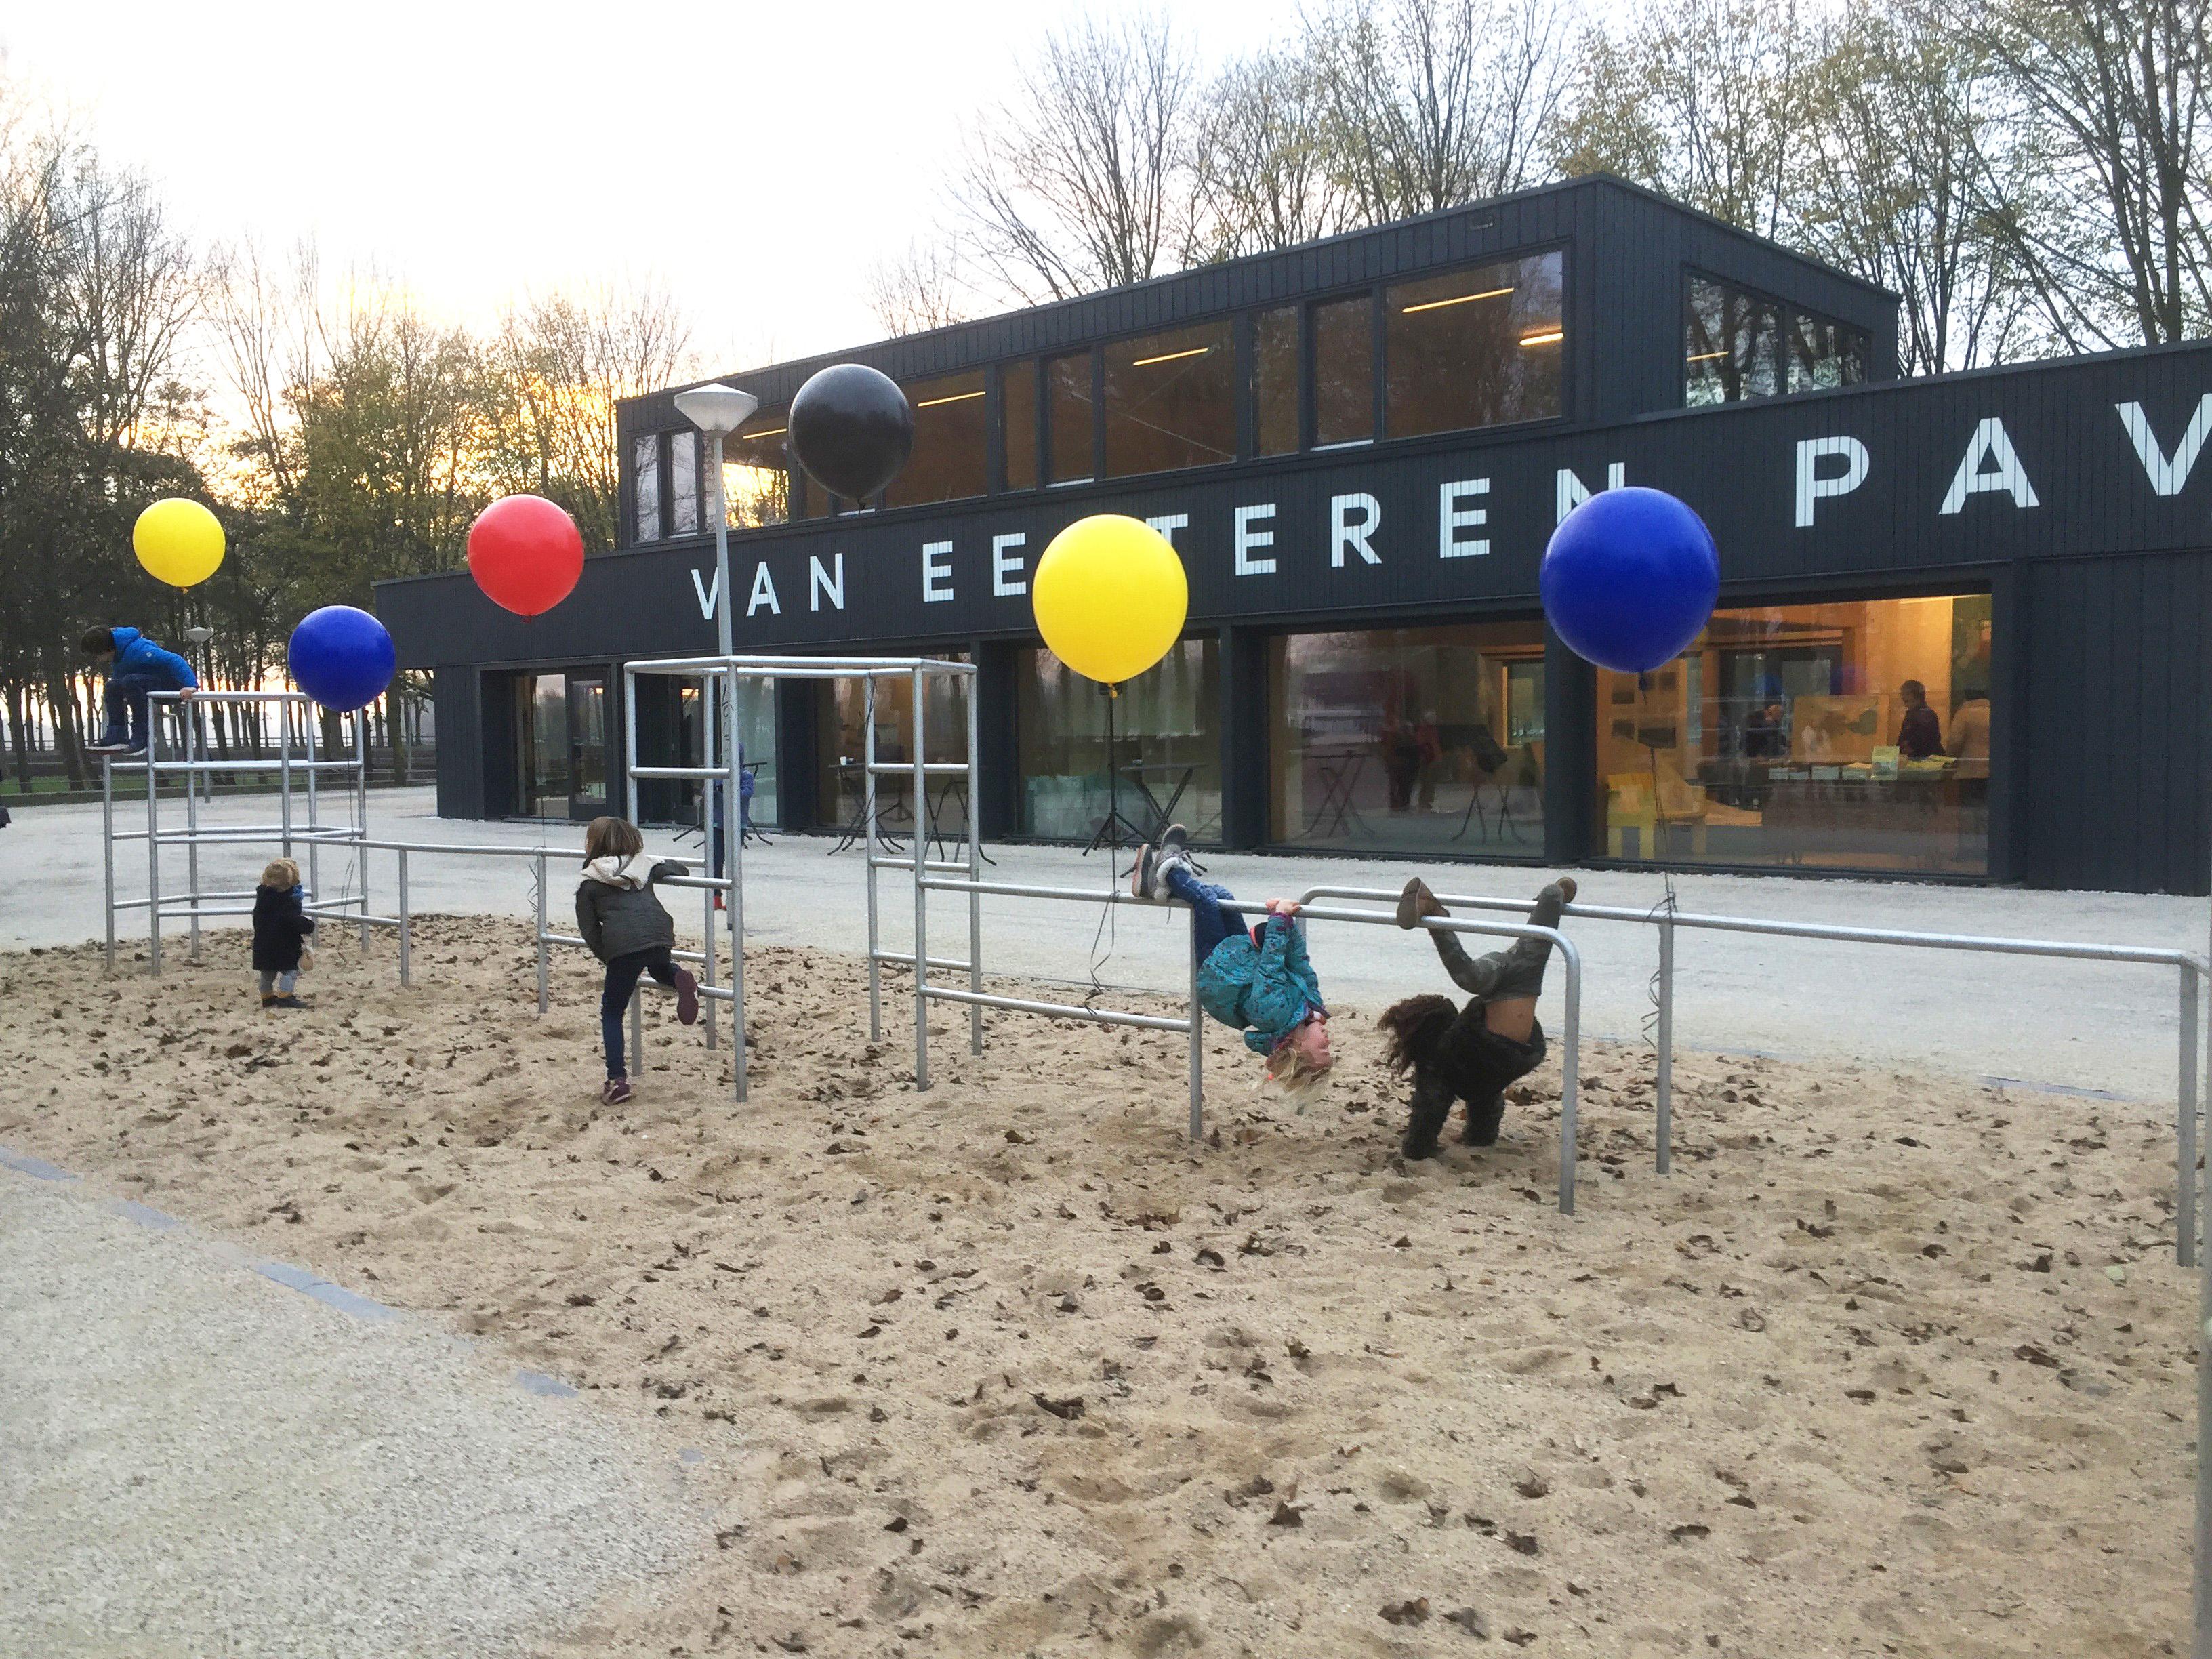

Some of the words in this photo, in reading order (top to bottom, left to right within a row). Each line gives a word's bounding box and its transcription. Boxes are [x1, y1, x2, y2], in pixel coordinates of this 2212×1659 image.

[691, 553, 844, 620] VAN
[922, 462, 1625, 602] EETERE
[1795, 393, 2212, 527] PAV
